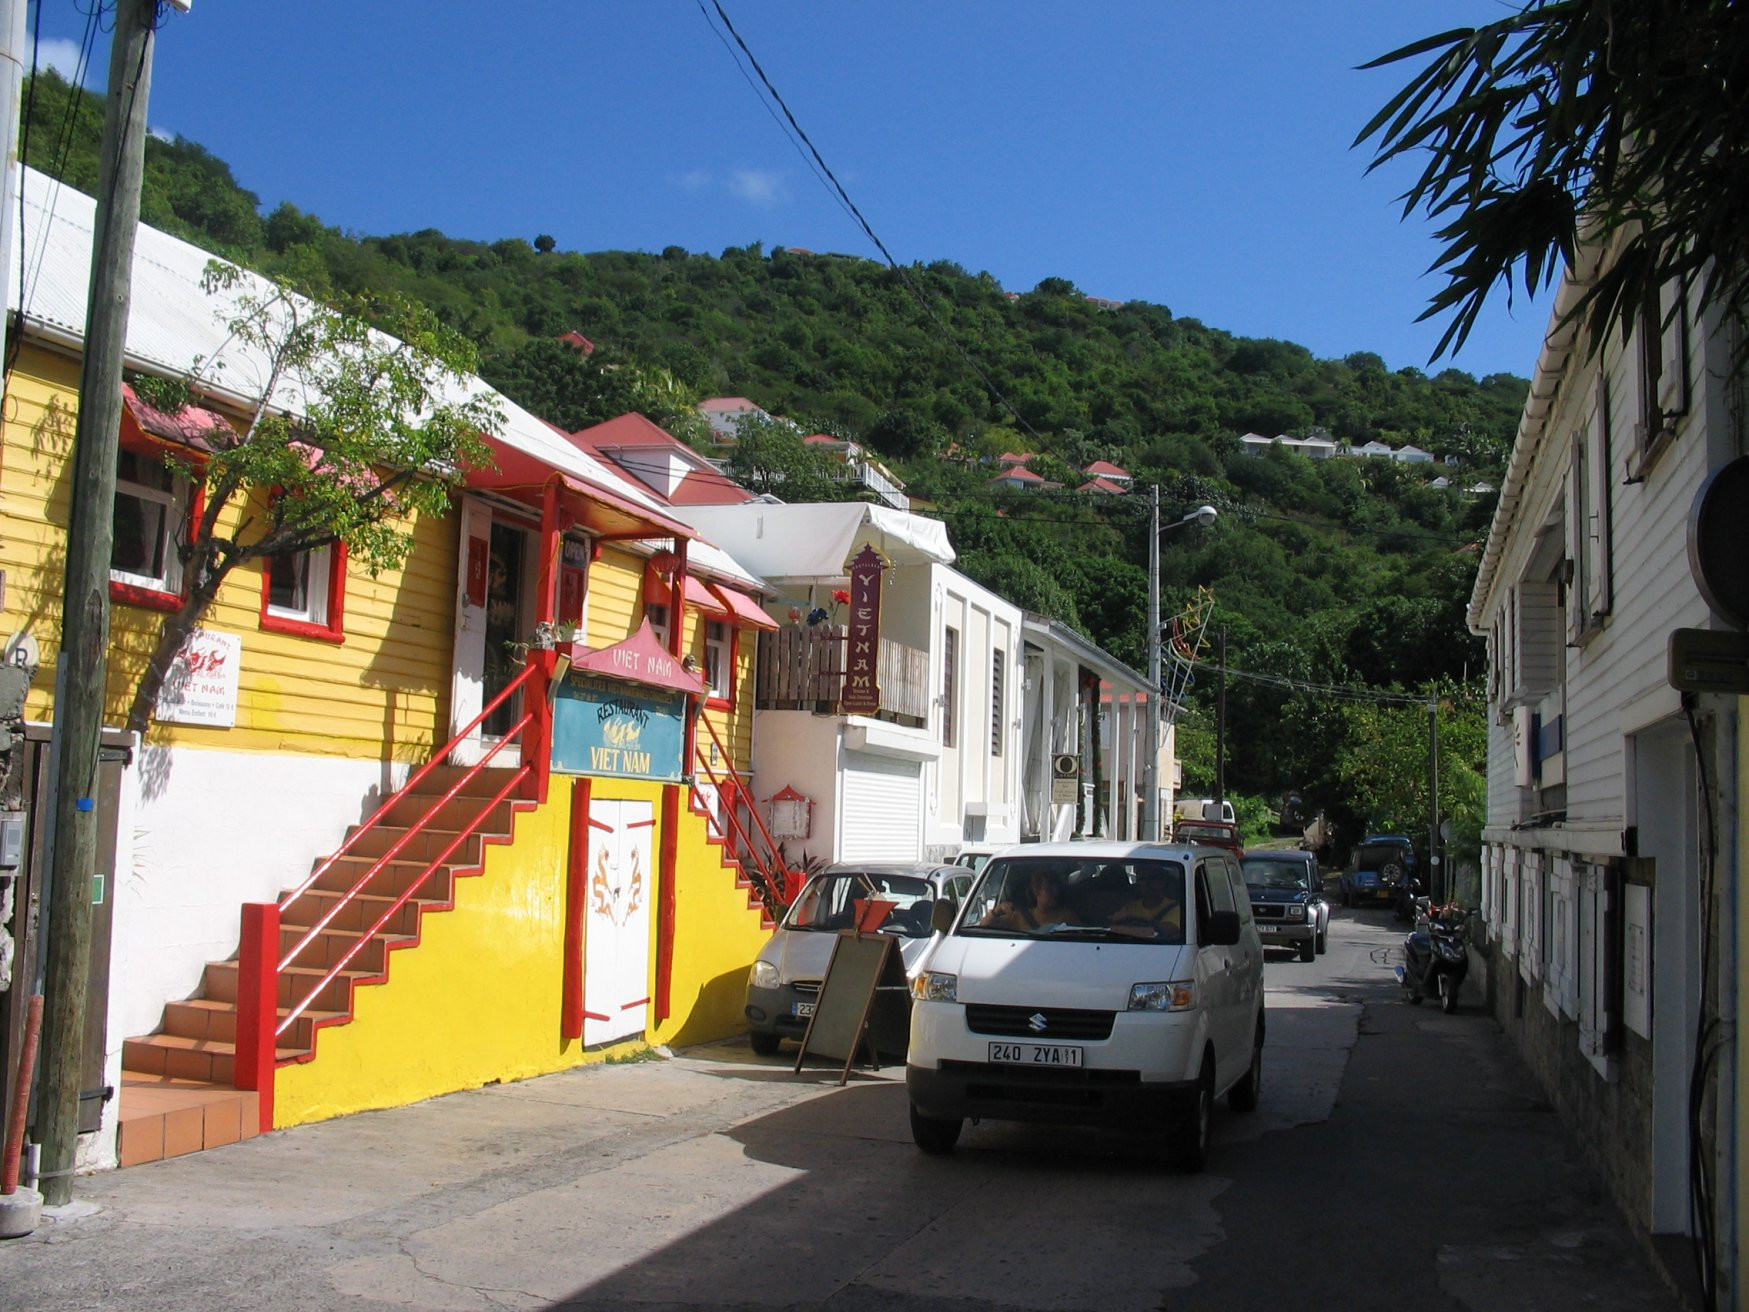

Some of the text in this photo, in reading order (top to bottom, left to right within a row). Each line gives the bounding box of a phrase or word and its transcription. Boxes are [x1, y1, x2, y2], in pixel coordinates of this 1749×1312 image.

[613, 648, 673, 678] VIET NAM
[201, 684, 226, 696] NAM
[596, 699, 650, 730] RESTAURANT
[590, 746, 651, 775] VIET NAM
[993, 1045, 1021, 1061] 240
[1034, 1047, 1060, 1063] ZYA
